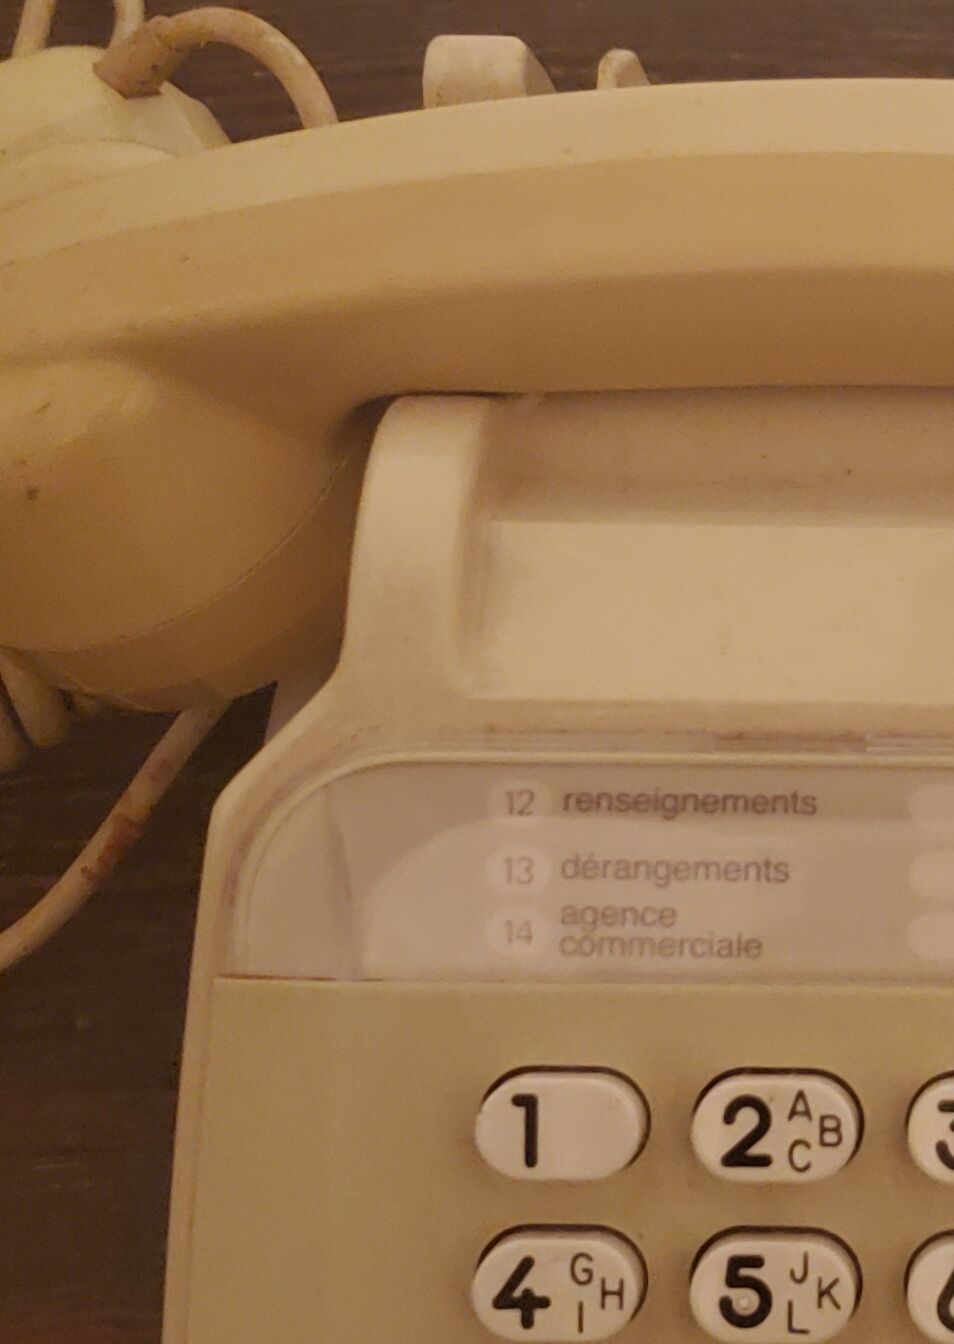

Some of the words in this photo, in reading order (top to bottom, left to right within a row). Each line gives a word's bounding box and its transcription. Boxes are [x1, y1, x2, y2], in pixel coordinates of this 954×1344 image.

[504, 789, 536, 816] 12
[562, 788, 818, 821] renseignements
[503, 857, 535, 884] 13
[560, 854, 790, 888] dérangements
[503, 920, 533, 945] 14
[559, 932, 763, 959] commerciale
[560, 904, 678, 932] agence
[511, 1093, 539, 1169] 1
[720, 1094, 773, 1168] 2
[492, 1256, 552, 1330] 4
[718, 1254, 773, 1329] 5
